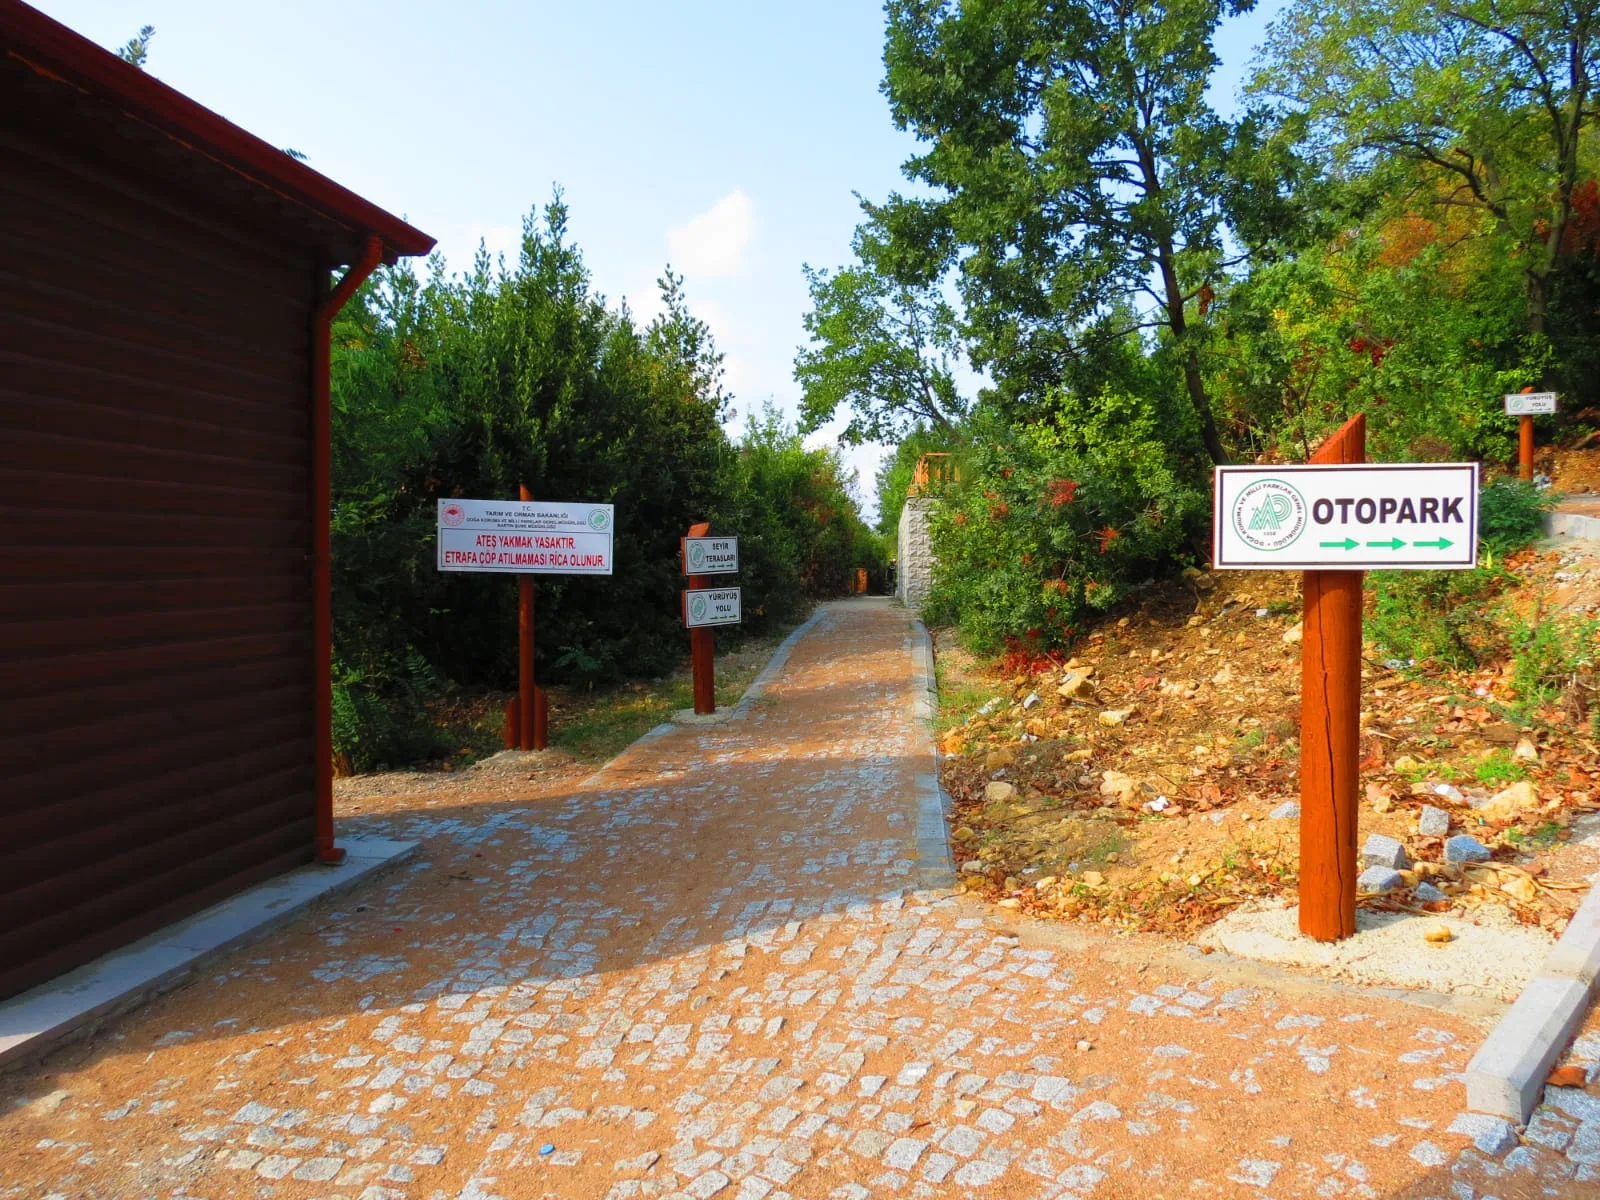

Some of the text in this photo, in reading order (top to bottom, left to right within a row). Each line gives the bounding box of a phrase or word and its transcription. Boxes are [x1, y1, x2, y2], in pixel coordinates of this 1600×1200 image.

[1263, 483, 1292, 494] PARKLAR
[1312, 497, 1464, 524] OTOPARK
[476, 535, 576, 549] ATEŞ YAKMAK YASAKTIR.
[712, 541, 729, 550] SEYİR
[445, 550, 605, 566] ETRAFA ÇÖP ATILMAMASI RİCA OLUNUR.
[706, 554, 736, 562] TERASLARI
[715, 604, 731, 612] YOLU
